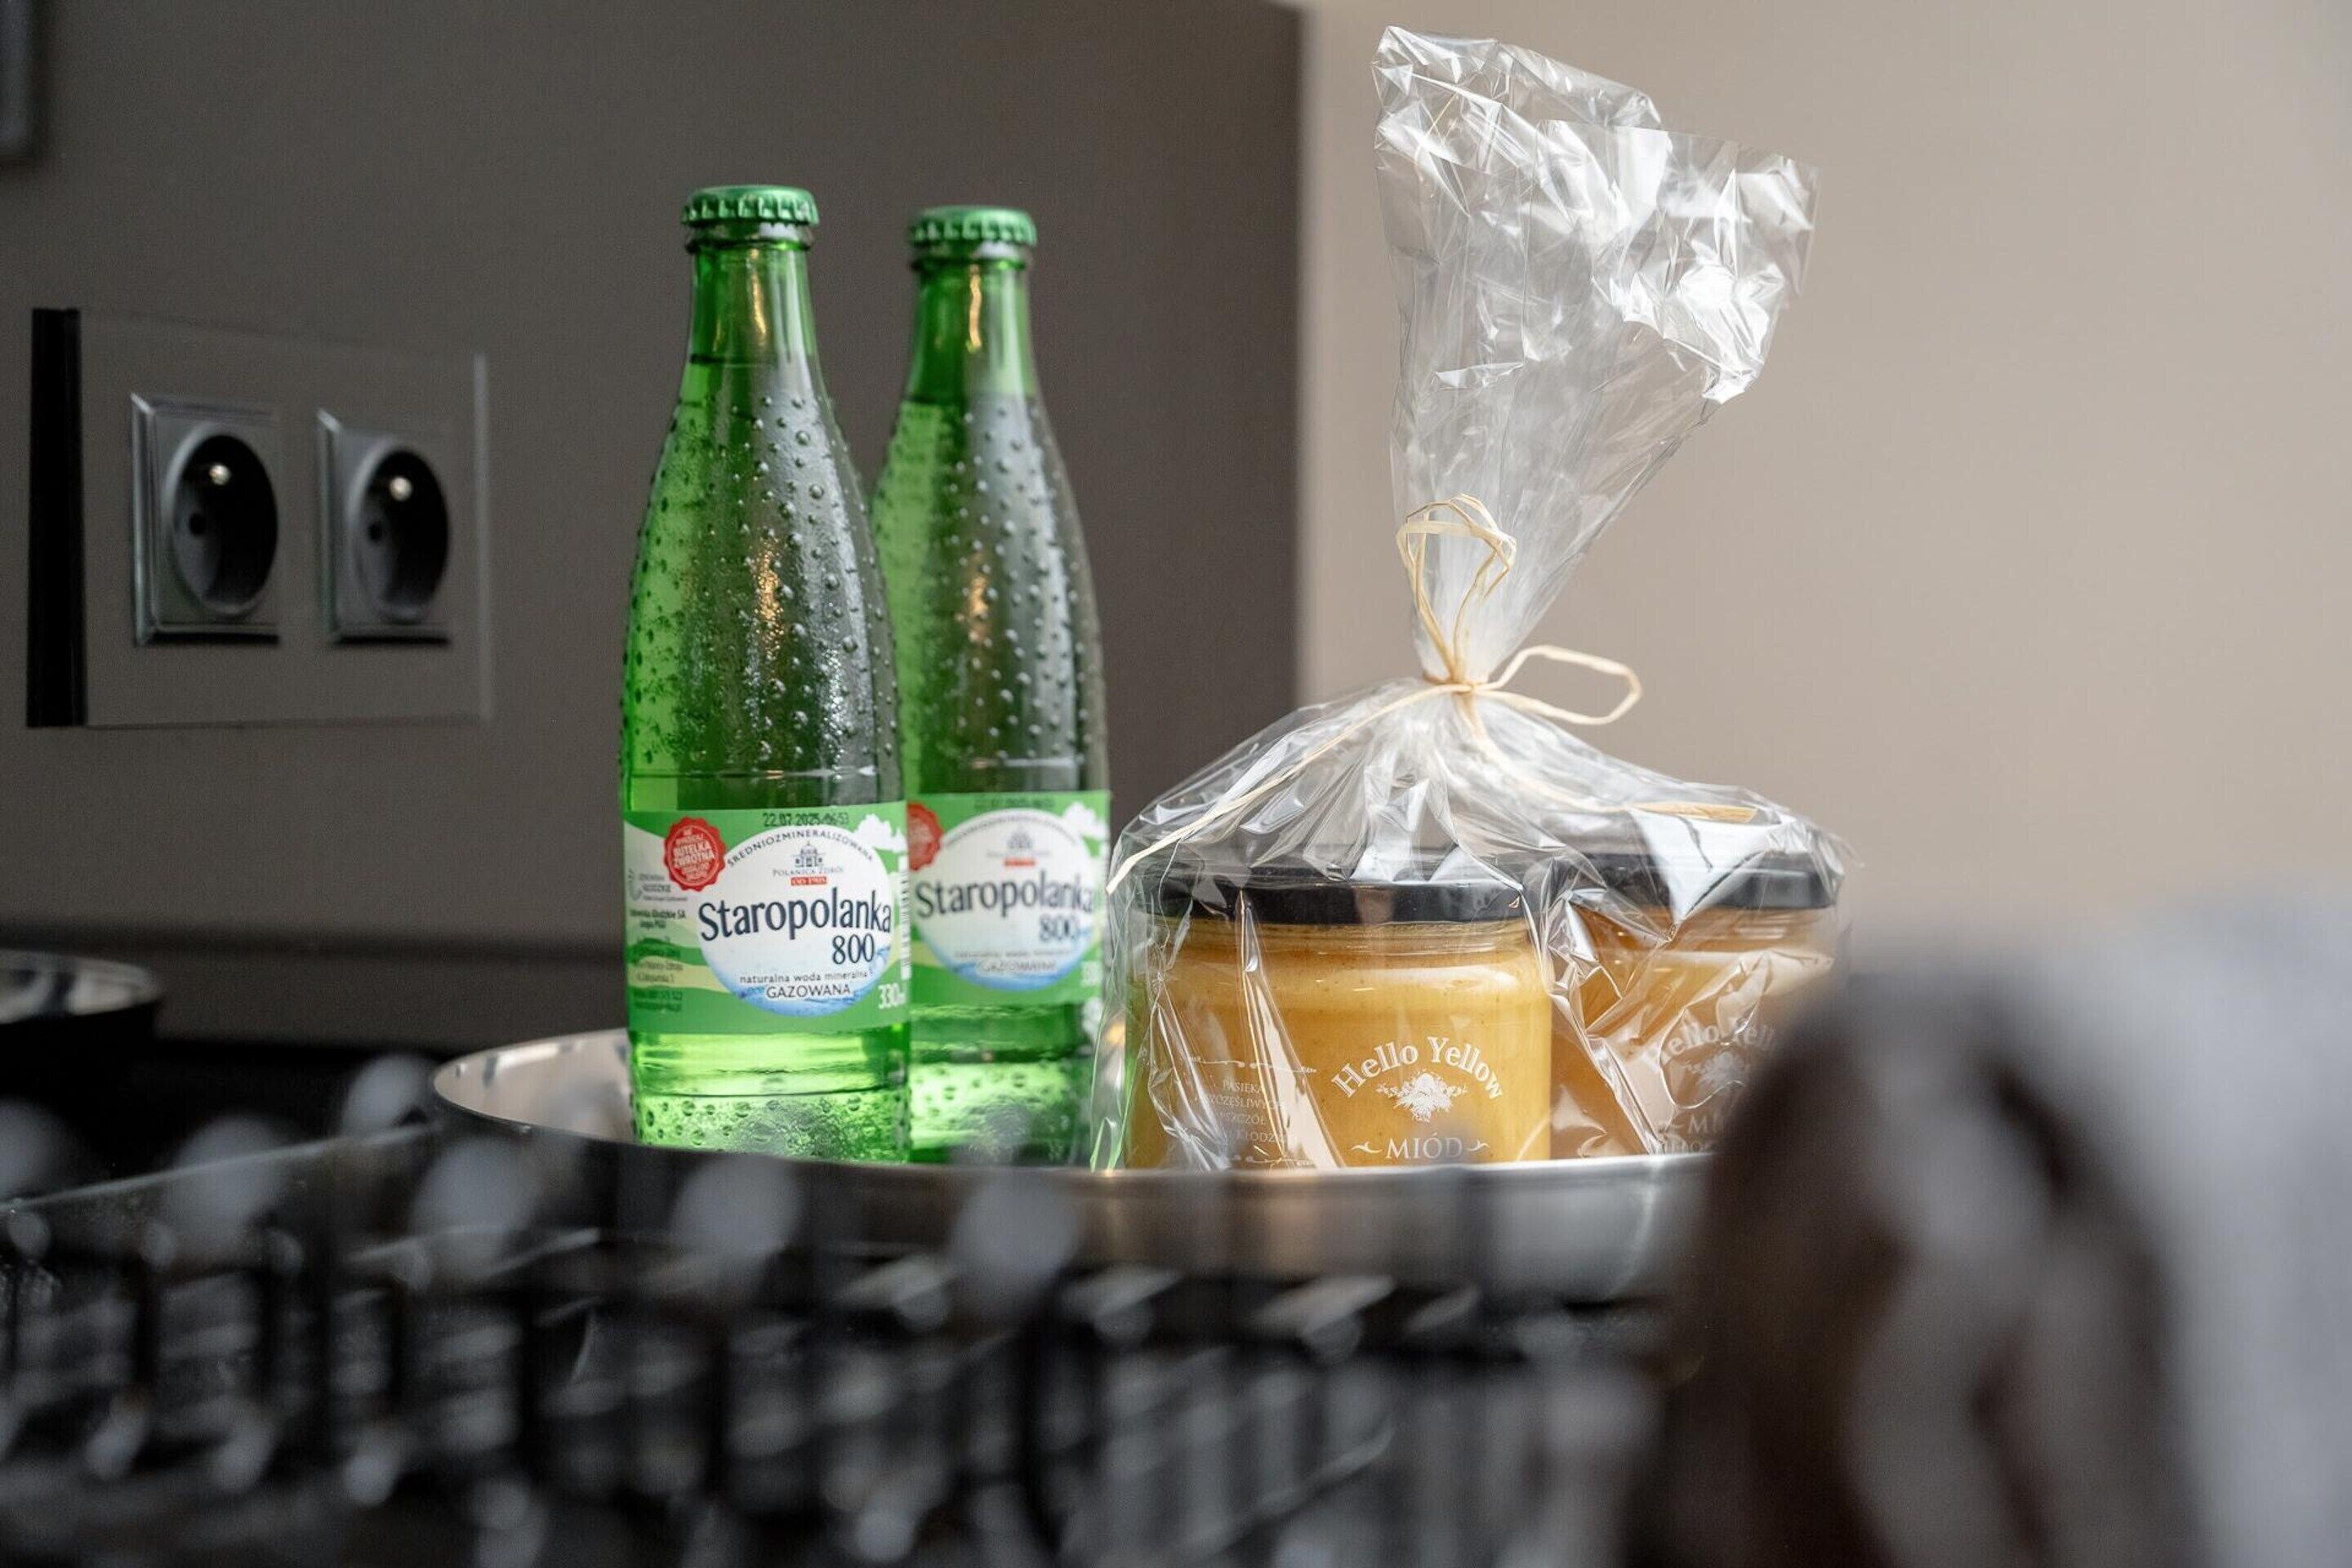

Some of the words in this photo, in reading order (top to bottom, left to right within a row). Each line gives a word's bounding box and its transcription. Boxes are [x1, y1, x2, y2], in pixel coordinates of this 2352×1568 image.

[915, 870, 1094, 920] Staropolanka
[698, 887, 892, 942] Staropolanka
[1039, 913, 1080, 942] 800
[832, 933, 876, 964] 800
[739, 974, 791, 983] naturalna
[793, 972, 822, 982] woda
[824, 970, 867, 981] mineralna
[766, 983, 853, 999] GAZOWANA
[1330, 1042, 1419, 1098] Hello
[1426, 1036, 1504, 1100] Yellow
[1385, 1133, 1463, 1160] MIÓD
